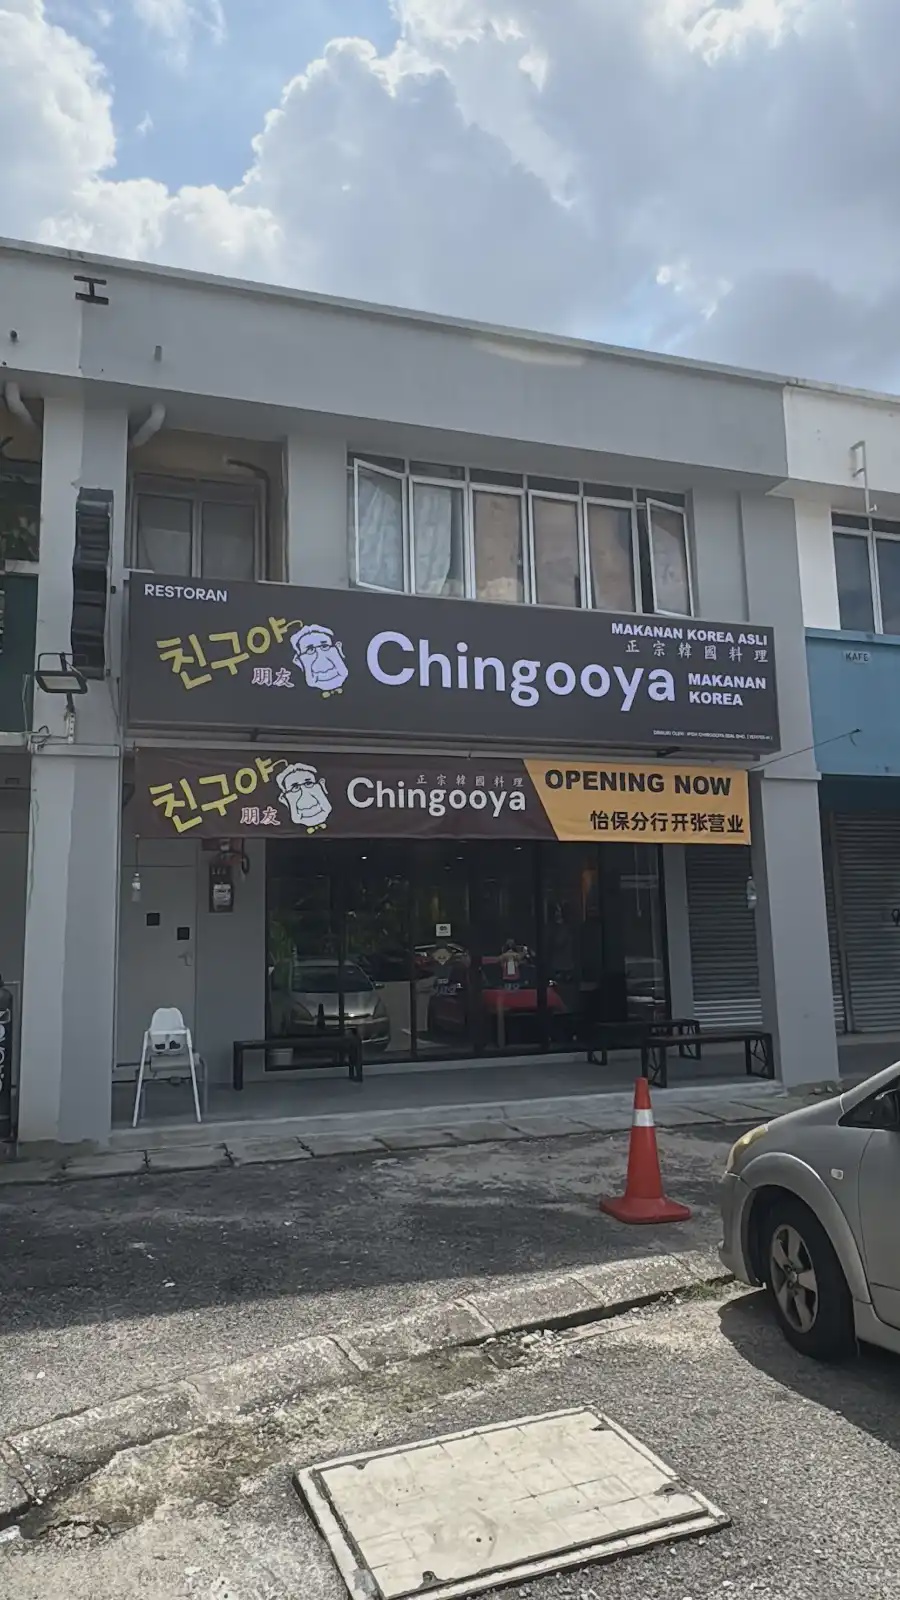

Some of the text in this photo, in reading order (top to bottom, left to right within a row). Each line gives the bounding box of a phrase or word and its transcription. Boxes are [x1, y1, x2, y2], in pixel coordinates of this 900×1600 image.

[144, 583, 228, 602] RESTORAN
[611, 622, 768, 646] MAKANAN KOREA ASLI
[156, 616, 302, 690] 친구야
[625, 639, 769, 663] 正宗韓國料理
[845, 652, 869, 662] KAFE
[251, 667, 295, 688] 朋友
[366, 631, 676, 711] Chingooya
[688, 672, 767, 689] MAKANAN
[689, 691, 744, 706] KOREA
[416, 774, 524, 788] 正宗韓國料理
[545, 769, 732, 796] OPENING NOW
[149, 757, 287, 833] 친구야
[347, 776, 526, 817] Chingooya
[240, 806, 280, 827] 朋友
[590, 810, 745, 834] 怡保分行开张营业
